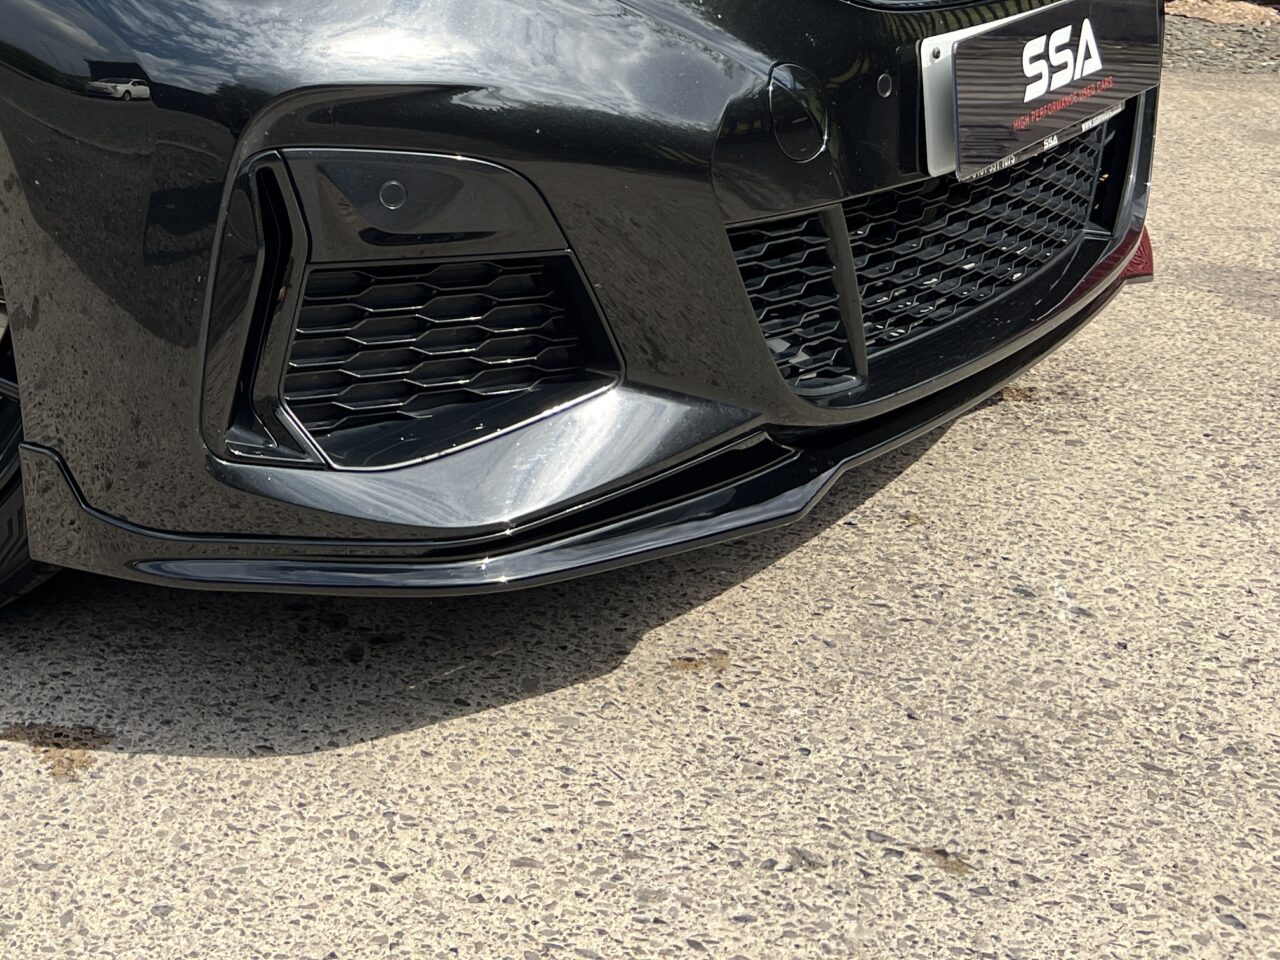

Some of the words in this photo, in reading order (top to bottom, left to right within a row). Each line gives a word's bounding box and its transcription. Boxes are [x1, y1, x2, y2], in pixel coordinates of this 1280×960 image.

[1021, 18, 1103, 103] SSA
[1012, 113, 1030, 131] HIGH
[1031, 91, 1078, 121] PERFORMANCE
[1079, 84, 1096, 101] USED
[1096, 76, 1114, 93] CARS
[1043, 135, 1059, 151] SSA
